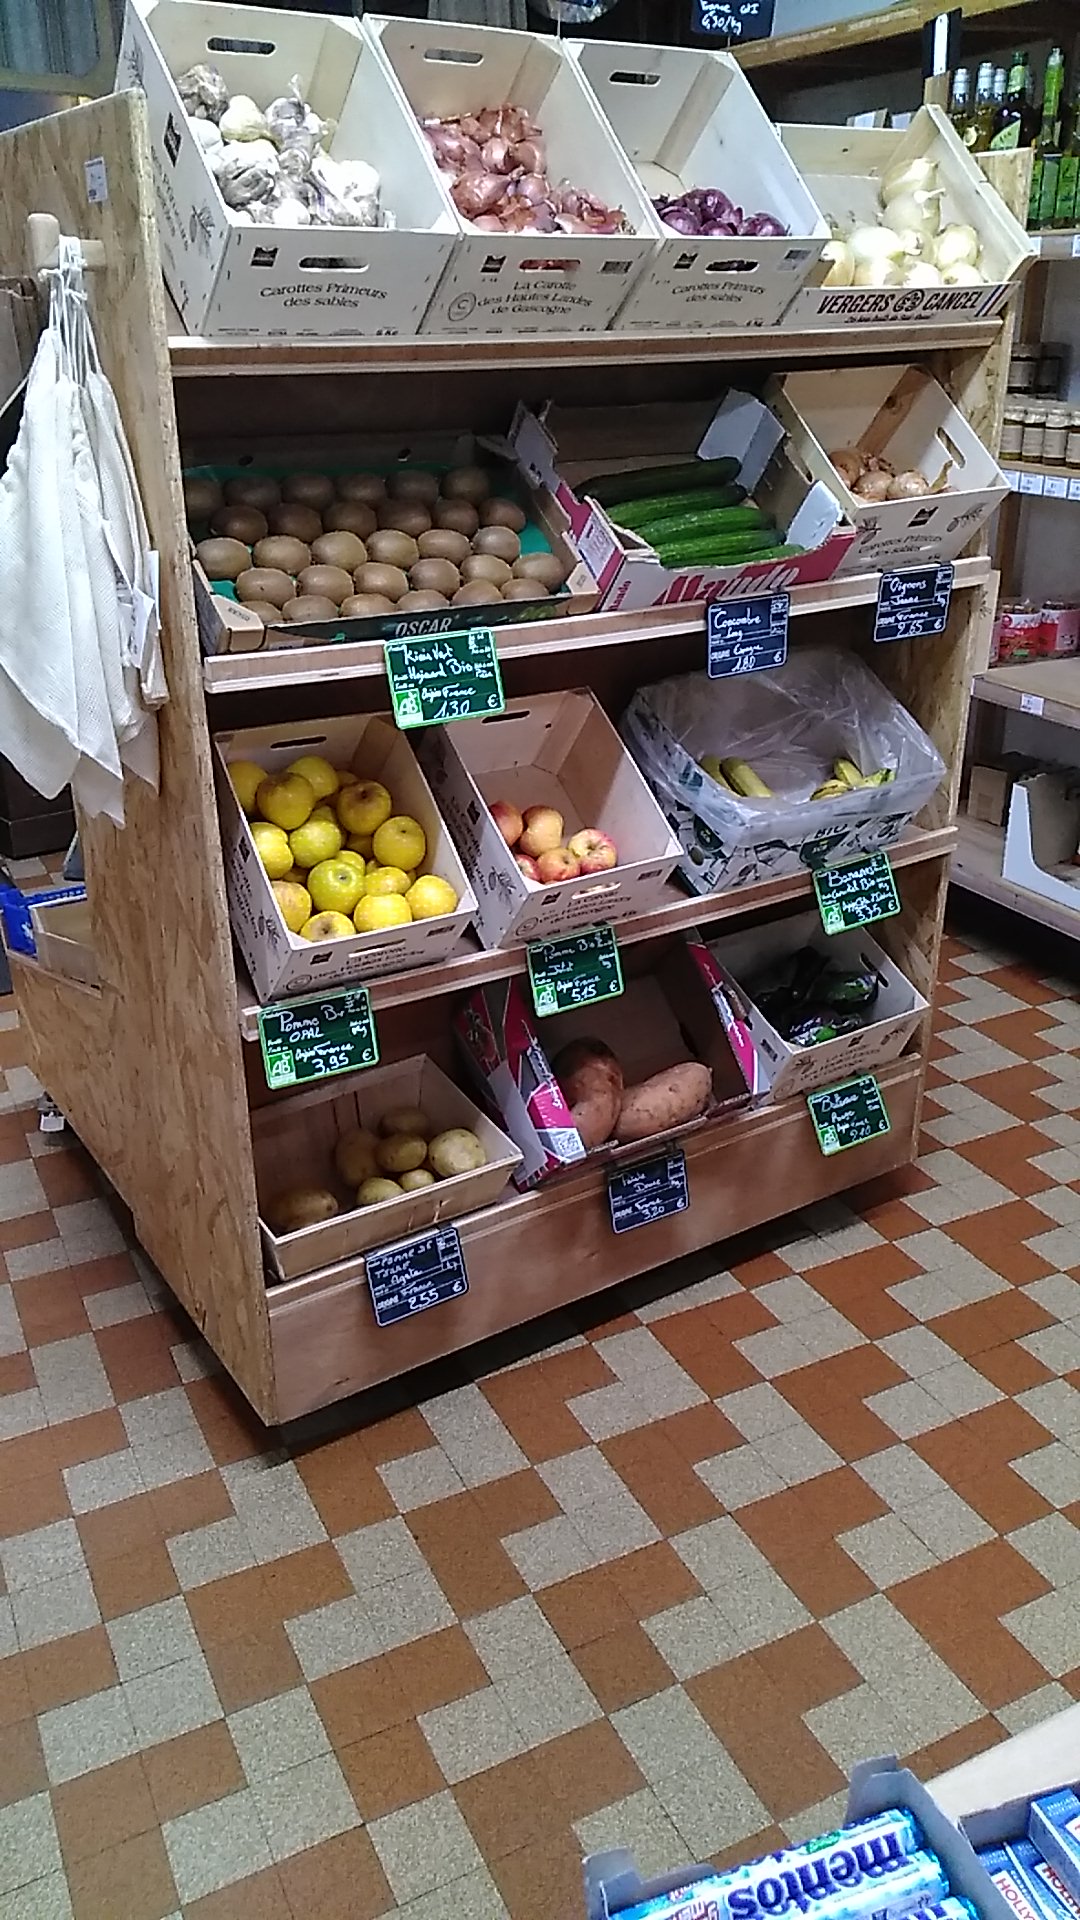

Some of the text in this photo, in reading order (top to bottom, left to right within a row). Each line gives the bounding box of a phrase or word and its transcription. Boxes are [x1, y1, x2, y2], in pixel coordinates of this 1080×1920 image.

[260, 282, 389, 300] Carottes Primeurs
[535, 280, 577, 291] Carotte
[671, 280, 765, 295] Carottes Primeurs
[283, 295, 360, 309] des sables
[477, 293, 593, 307] des Hautes Landes
[816, 294, 896, 314] VERGERS
[510, 303, 572, 317] Gascogne
[714, 607, 762, 629] Concombre
[896, 609, 929, 621] France
[394, 617, 453, 637] OSCAR
[933, 618, 943, 629] €
[773, 650, 782, 662] €
[446, 658, 474, 675] Bio
[442, 683, 477, 698] France
[487, 694, 499, 708] €
[887, 900, 896, 910] €
[543, 944, 576, 962] Pomme
[609, 980, 618, 991] €
[279, 1010, 320, 1032] Pomme
[289, 1026, 325, 1043] OPAL
[314, 1041, 354, 1056] France
[311, 1047, 373, 1075] 3,95 €
[878, 1119, 886, 1130] €
[676, 1198, 685, 1208] €
[452, 1280, 463, 1292] €
[726, 1831, 911, 1920] mentos
